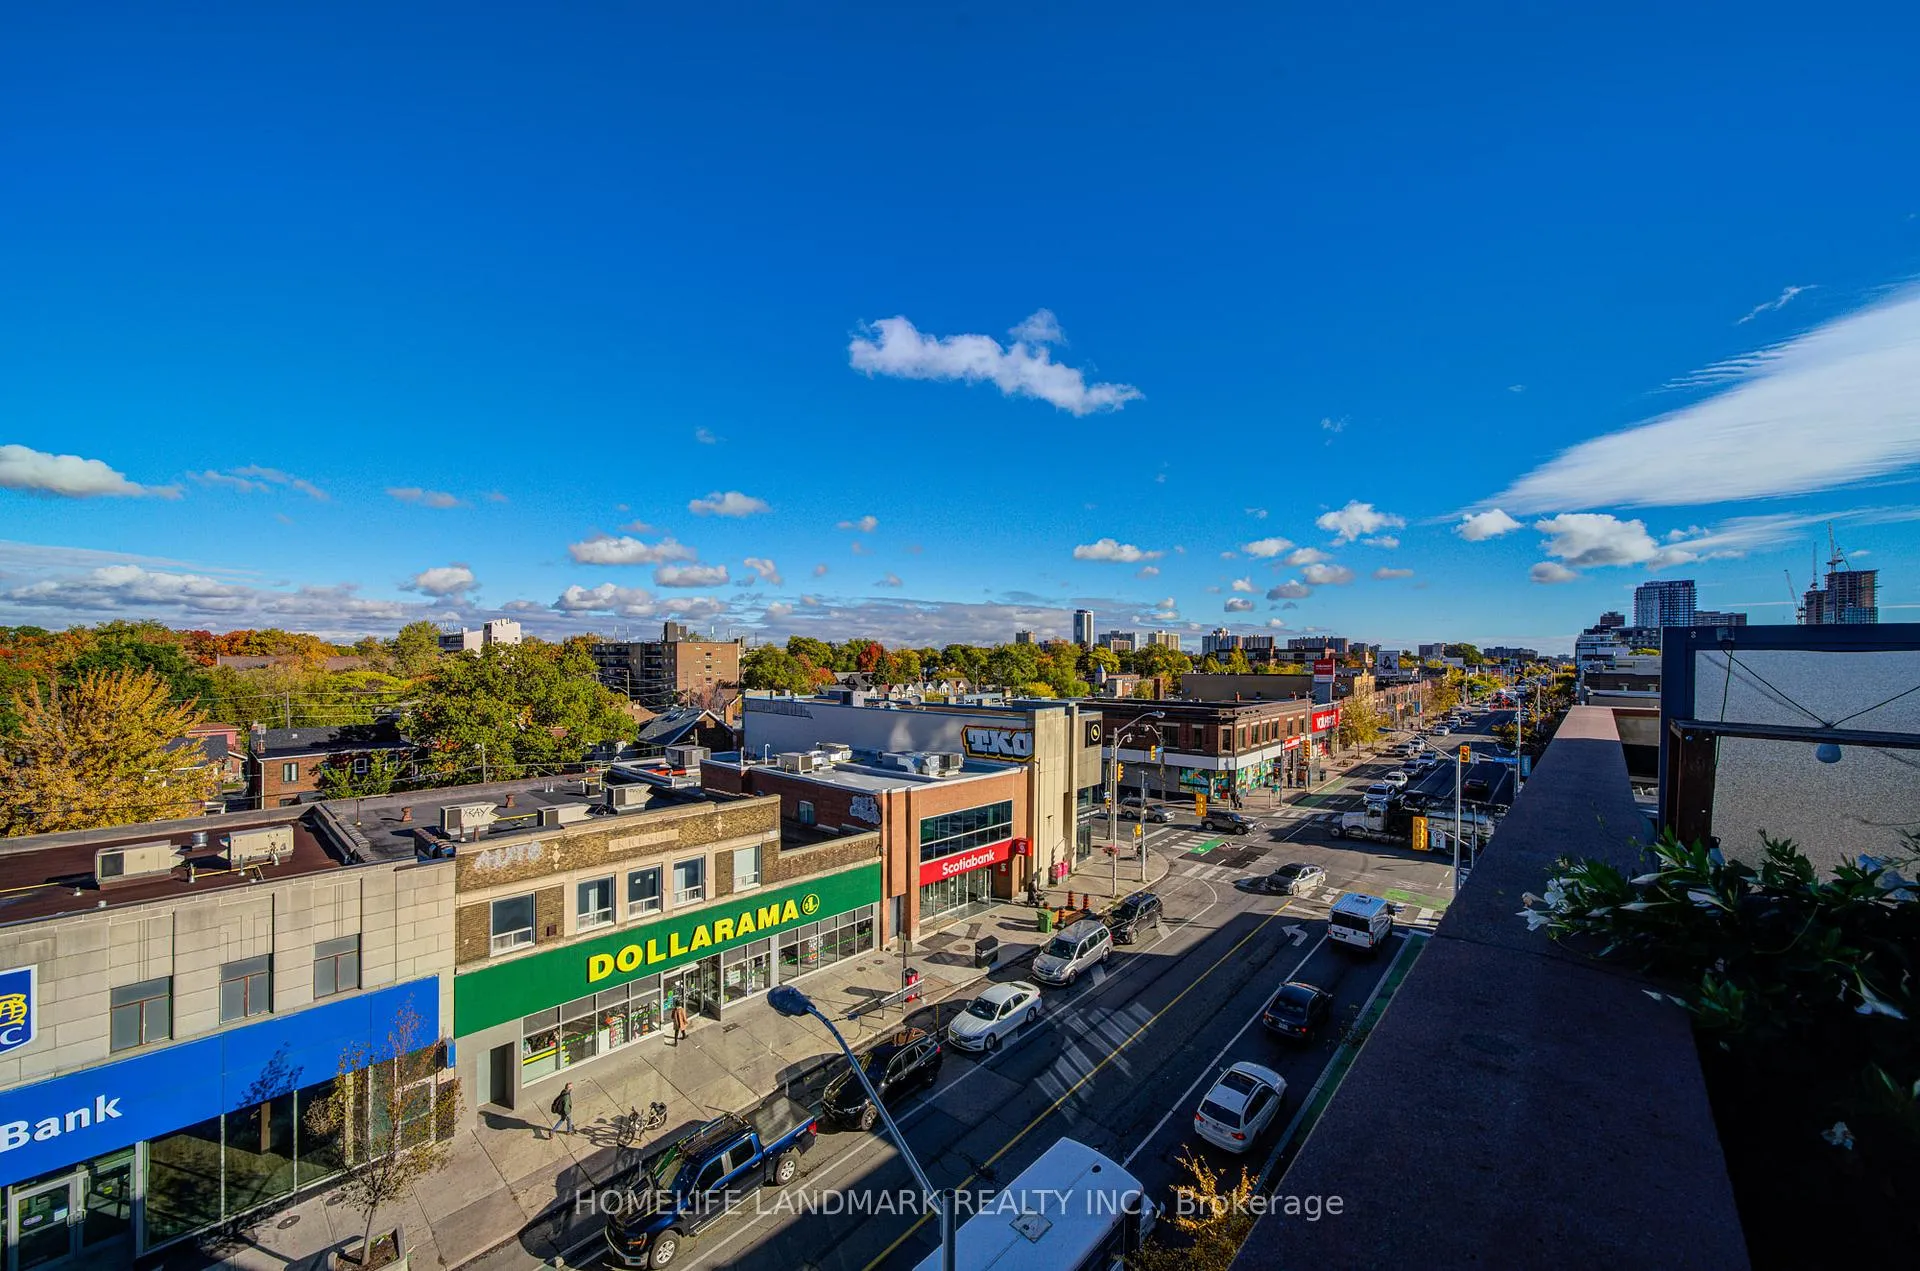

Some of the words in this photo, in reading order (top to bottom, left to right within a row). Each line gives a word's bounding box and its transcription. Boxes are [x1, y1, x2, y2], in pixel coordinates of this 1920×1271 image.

[966, 729, 1032, 756] TKO
[463, 806, 489, 818] XRAY
[942, 850, 995, 875] Scotiabank
[589, 899, 799, 983] DOLLARAMA
[0, 1094, 122, 1153] Bank
